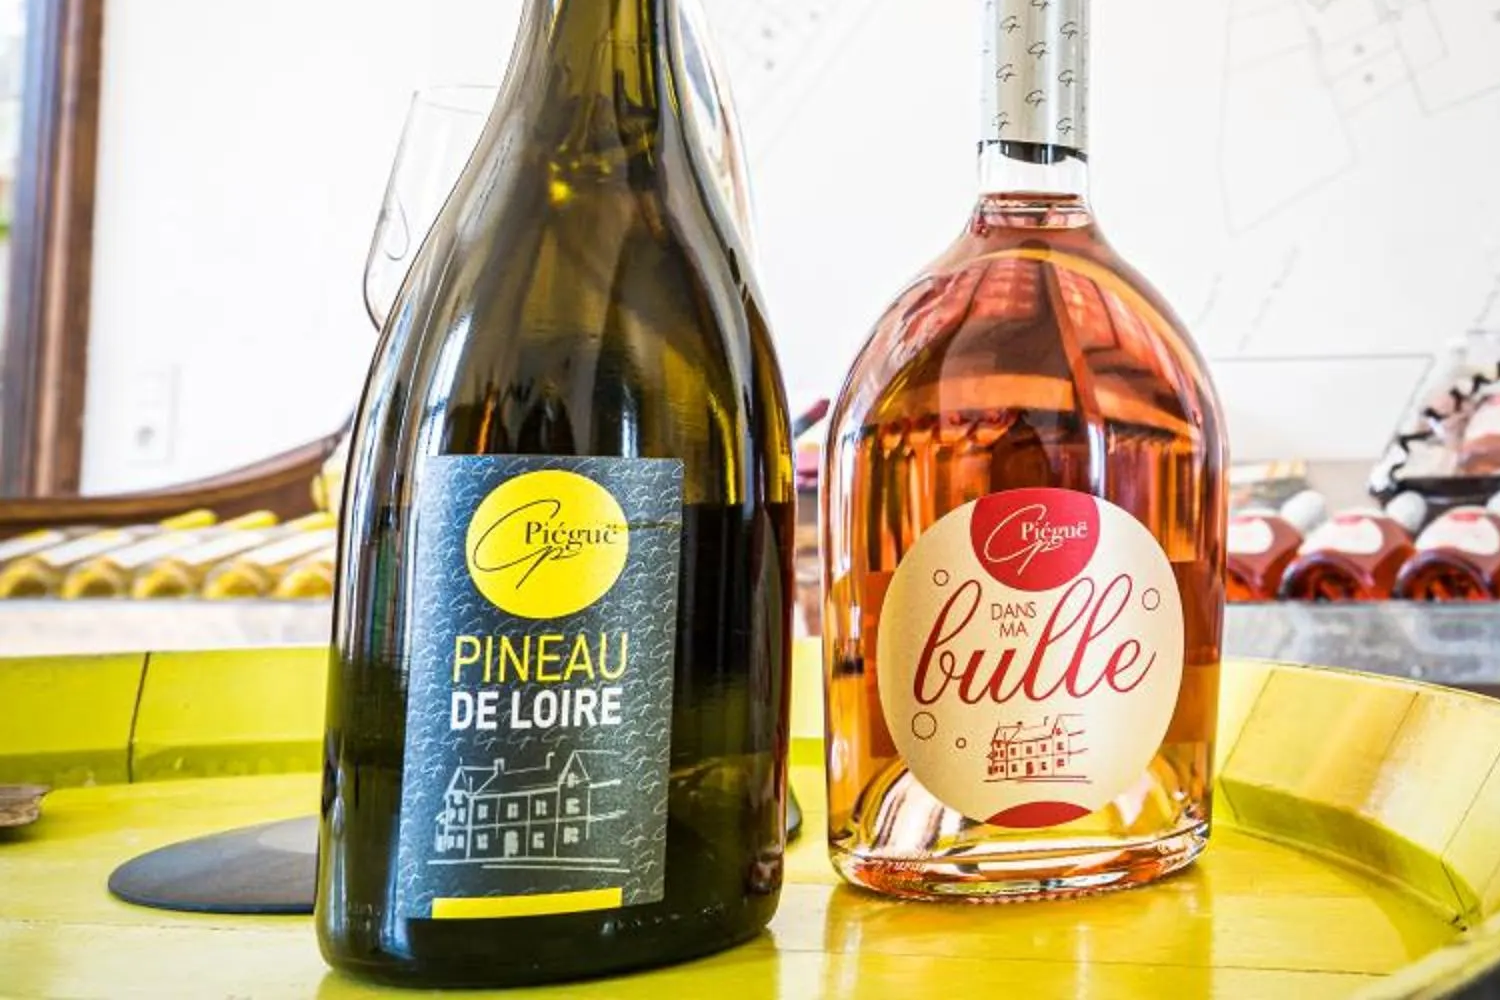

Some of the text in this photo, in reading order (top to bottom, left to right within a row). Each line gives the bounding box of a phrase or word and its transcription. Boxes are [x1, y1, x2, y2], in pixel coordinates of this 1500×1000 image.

[525, 521, 617, 551] Piéguë
[991, 601, 1037, 620] DANS
[913, 573, 1157, 705] bulle
[1000, 621, 1029, 638] MA
[452, 631, 629, 683] PINEAU
[450, 687, 623, 731] DE LOIRE
